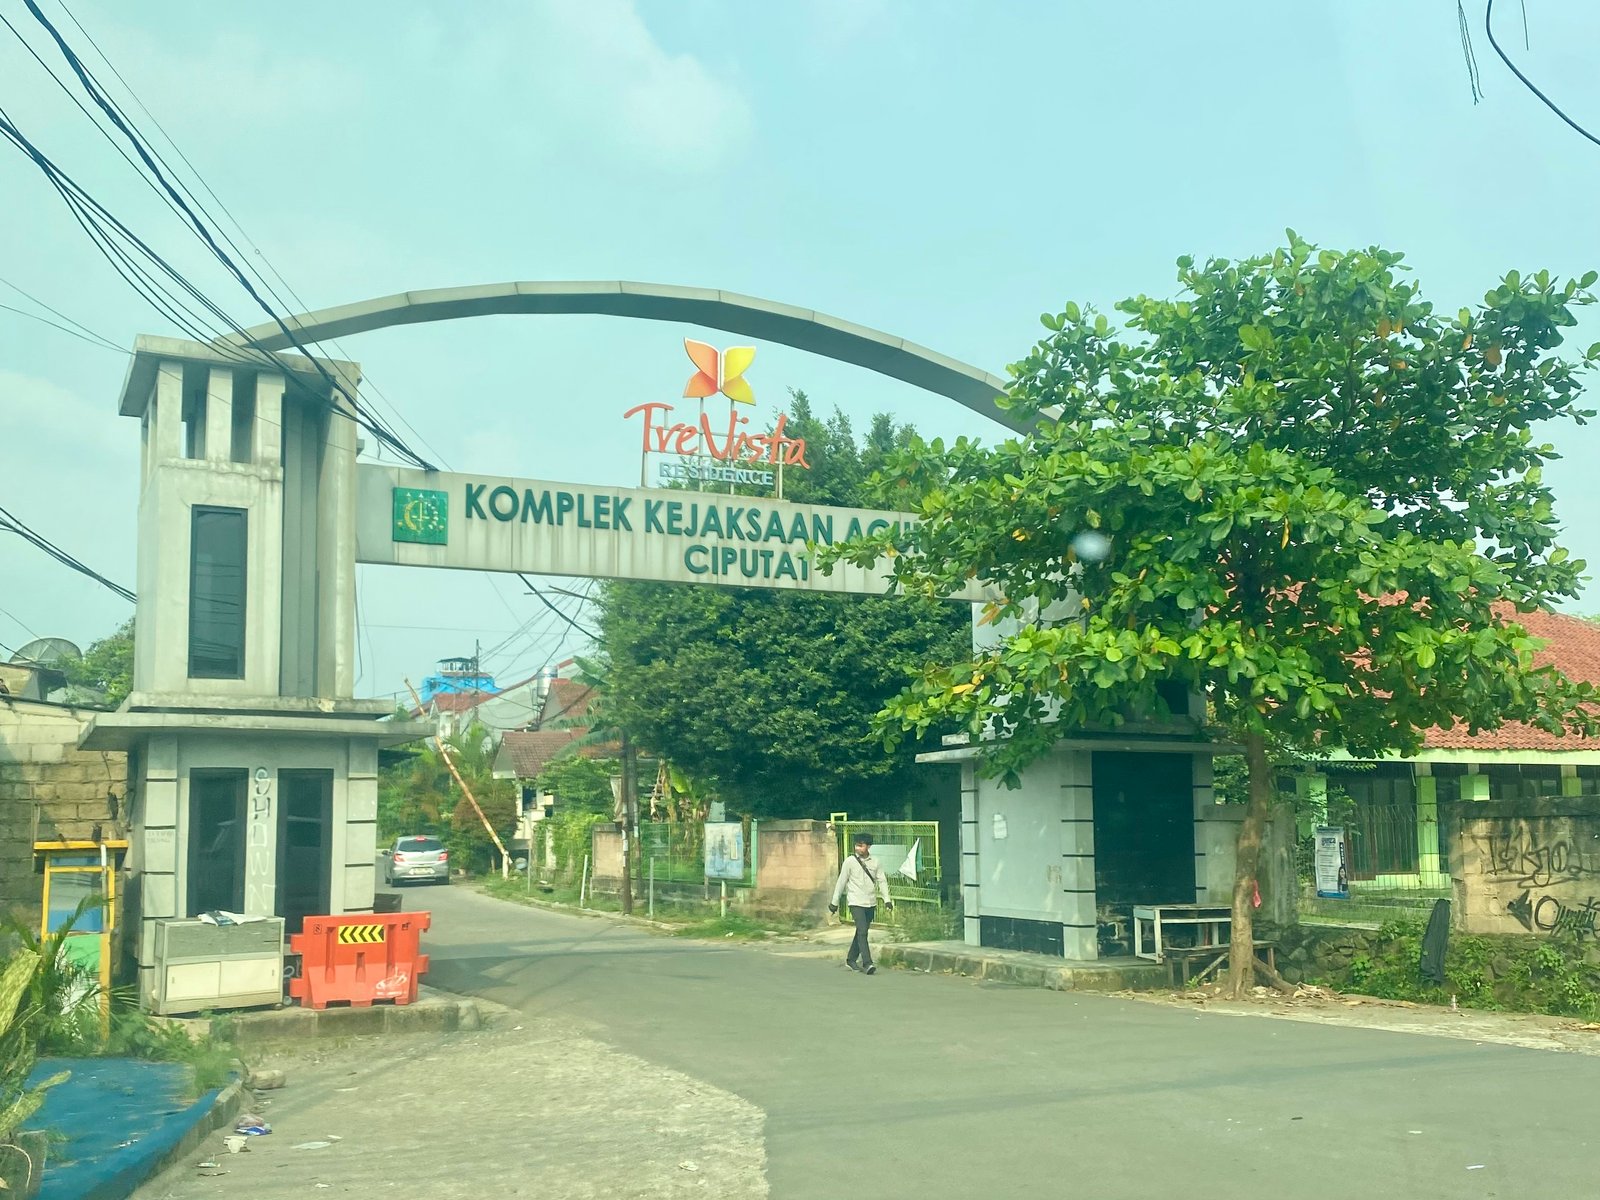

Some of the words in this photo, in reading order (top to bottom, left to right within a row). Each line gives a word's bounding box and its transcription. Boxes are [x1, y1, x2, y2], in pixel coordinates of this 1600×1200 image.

[659, 461, 774, 486] RESIDENCE
[465, 483, 633, 532] KOMPLEK
[644, 499, 834, 547] KEJAKSAAN
